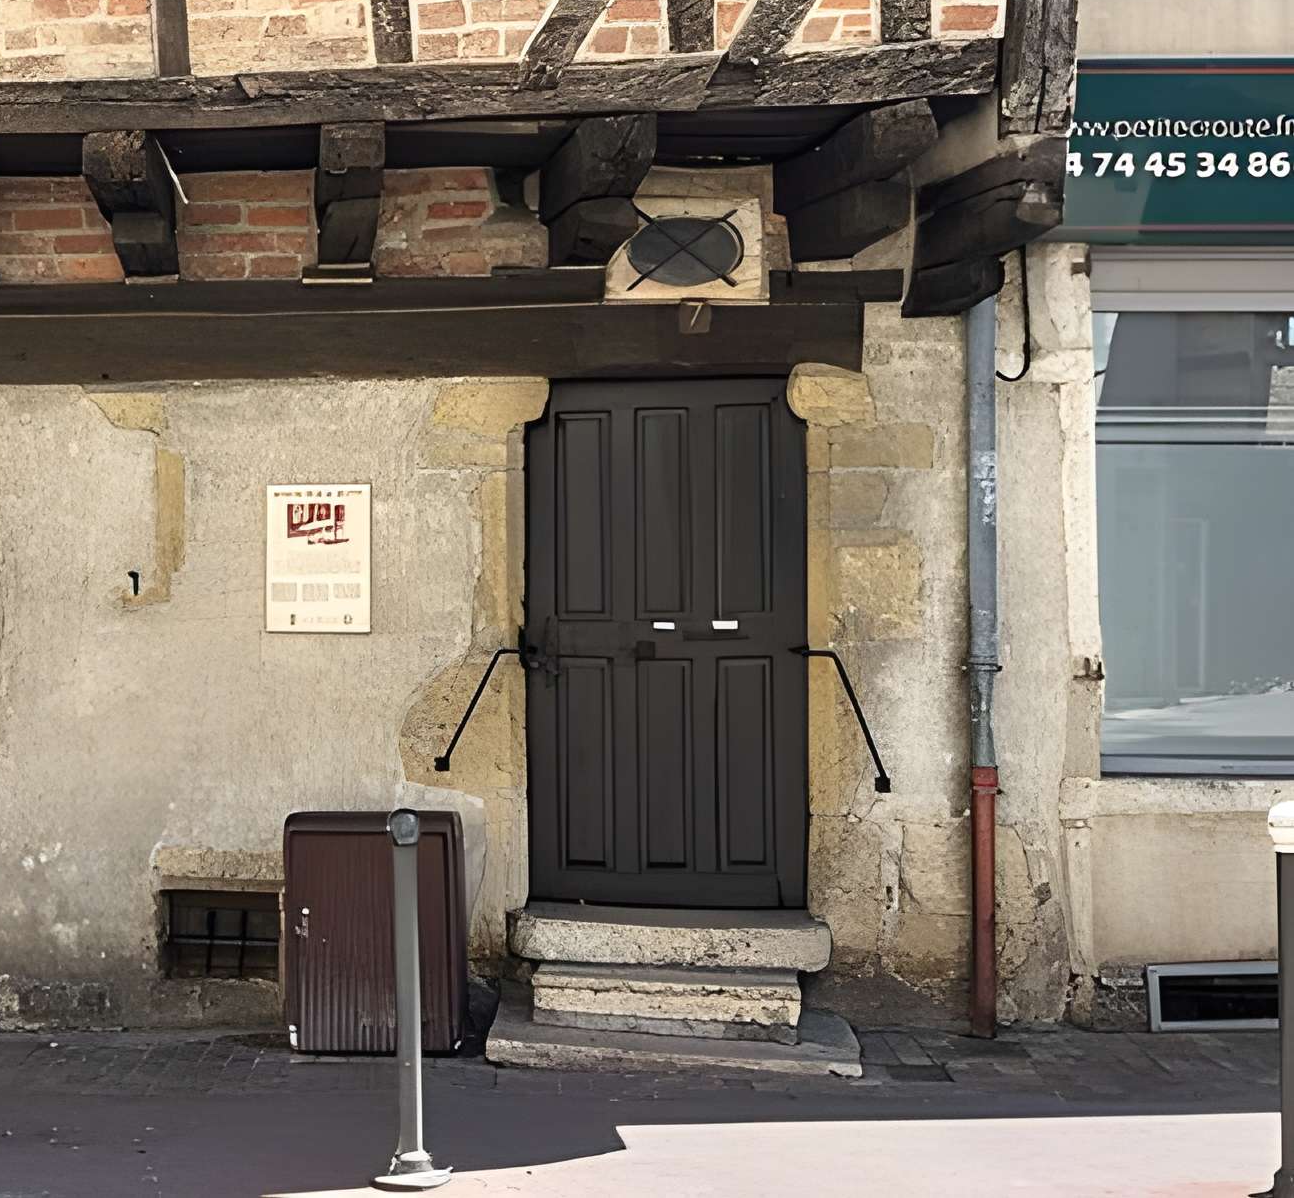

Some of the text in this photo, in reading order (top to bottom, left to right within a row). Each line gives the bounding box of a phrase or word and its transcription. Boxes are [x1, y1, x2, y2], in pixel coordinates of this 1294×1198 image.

[1092, 152, 1135, 178] 74
[1144, 152, 1186, 178] 45
[1196, 152, 1239, 178] 34
[1247, 151, 1291, 178] 86
